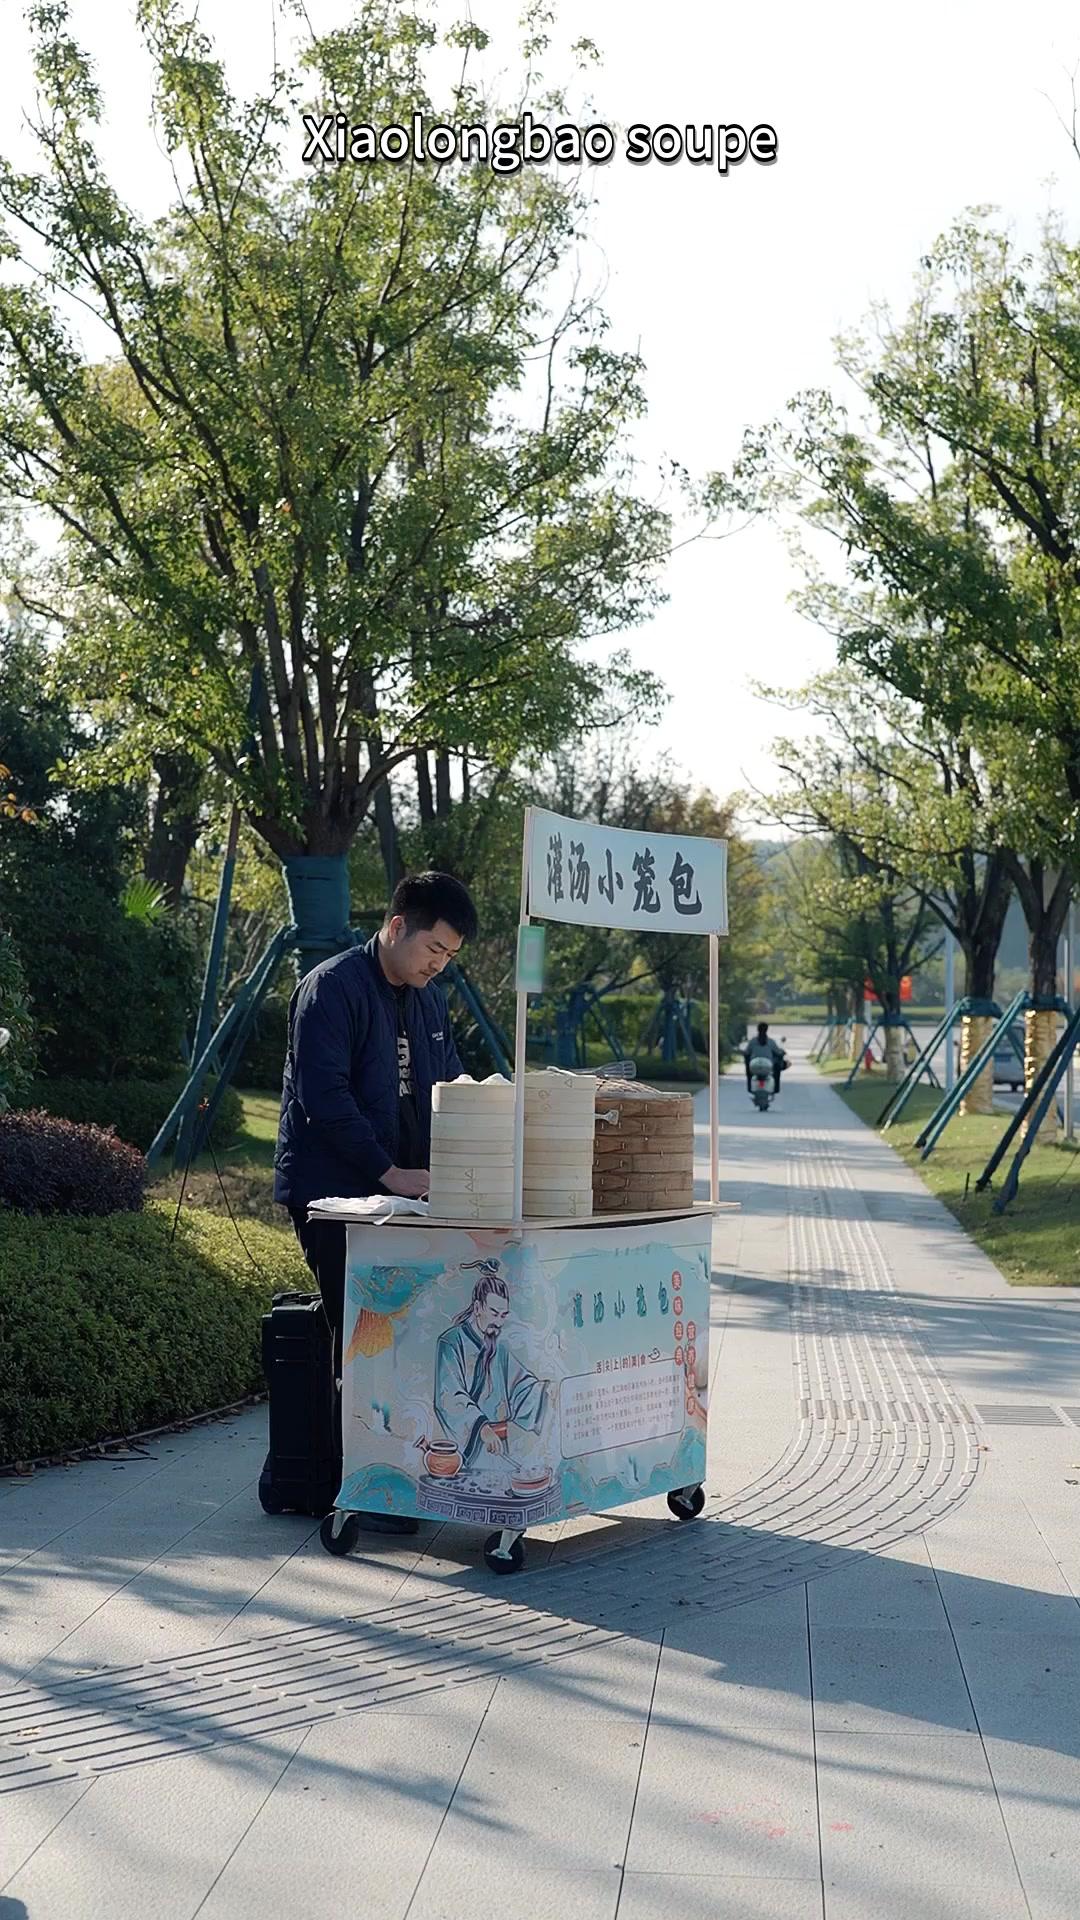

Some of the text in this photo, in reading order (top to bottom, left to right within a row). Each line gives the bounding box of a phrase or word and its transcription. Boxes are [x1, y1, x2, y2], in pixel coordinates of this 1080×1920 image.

[547, 832, 702, 915] 灌汤小笼包
